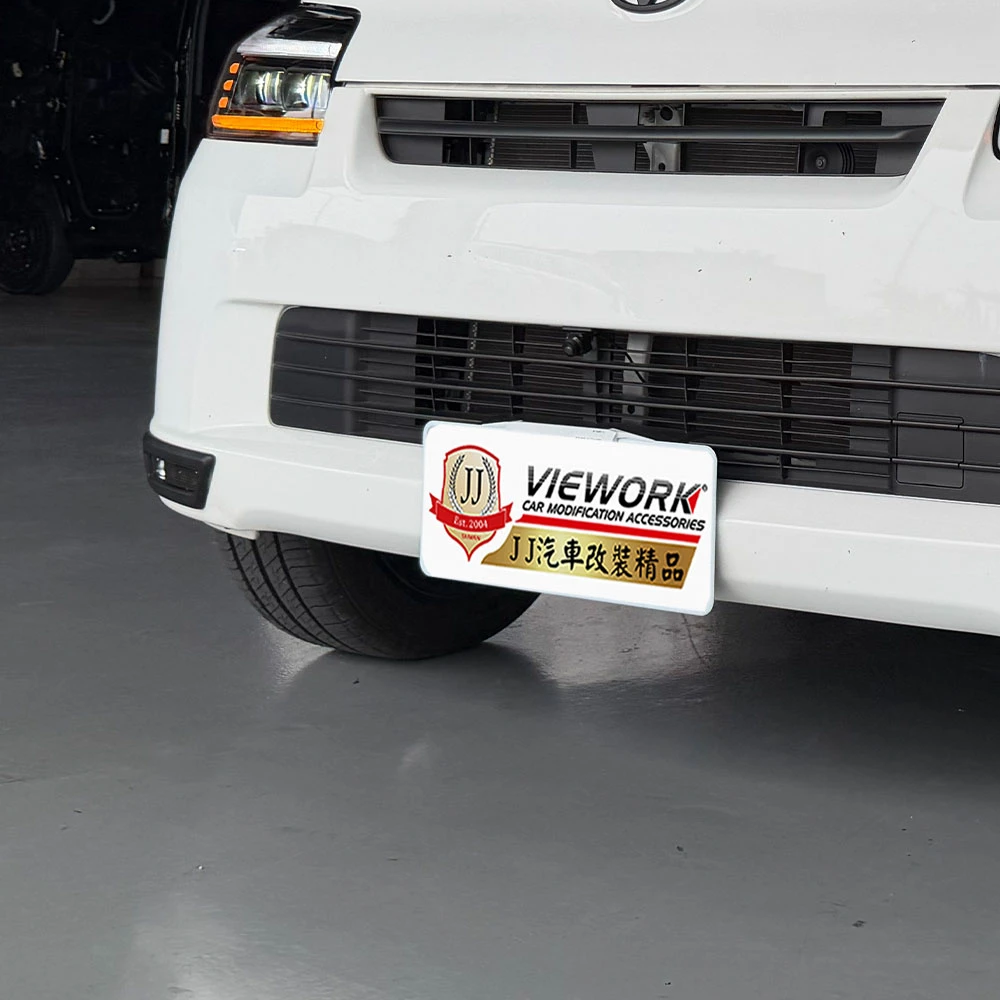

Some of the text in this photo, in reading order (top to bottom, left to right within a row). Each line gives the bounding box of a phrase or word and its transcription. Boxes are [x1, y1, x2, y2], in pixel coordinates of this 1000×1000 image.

[460, 467, 484, 505] JJ
[522, 499, 706, 532] CAR MODIFICATION ACCESSORIES
